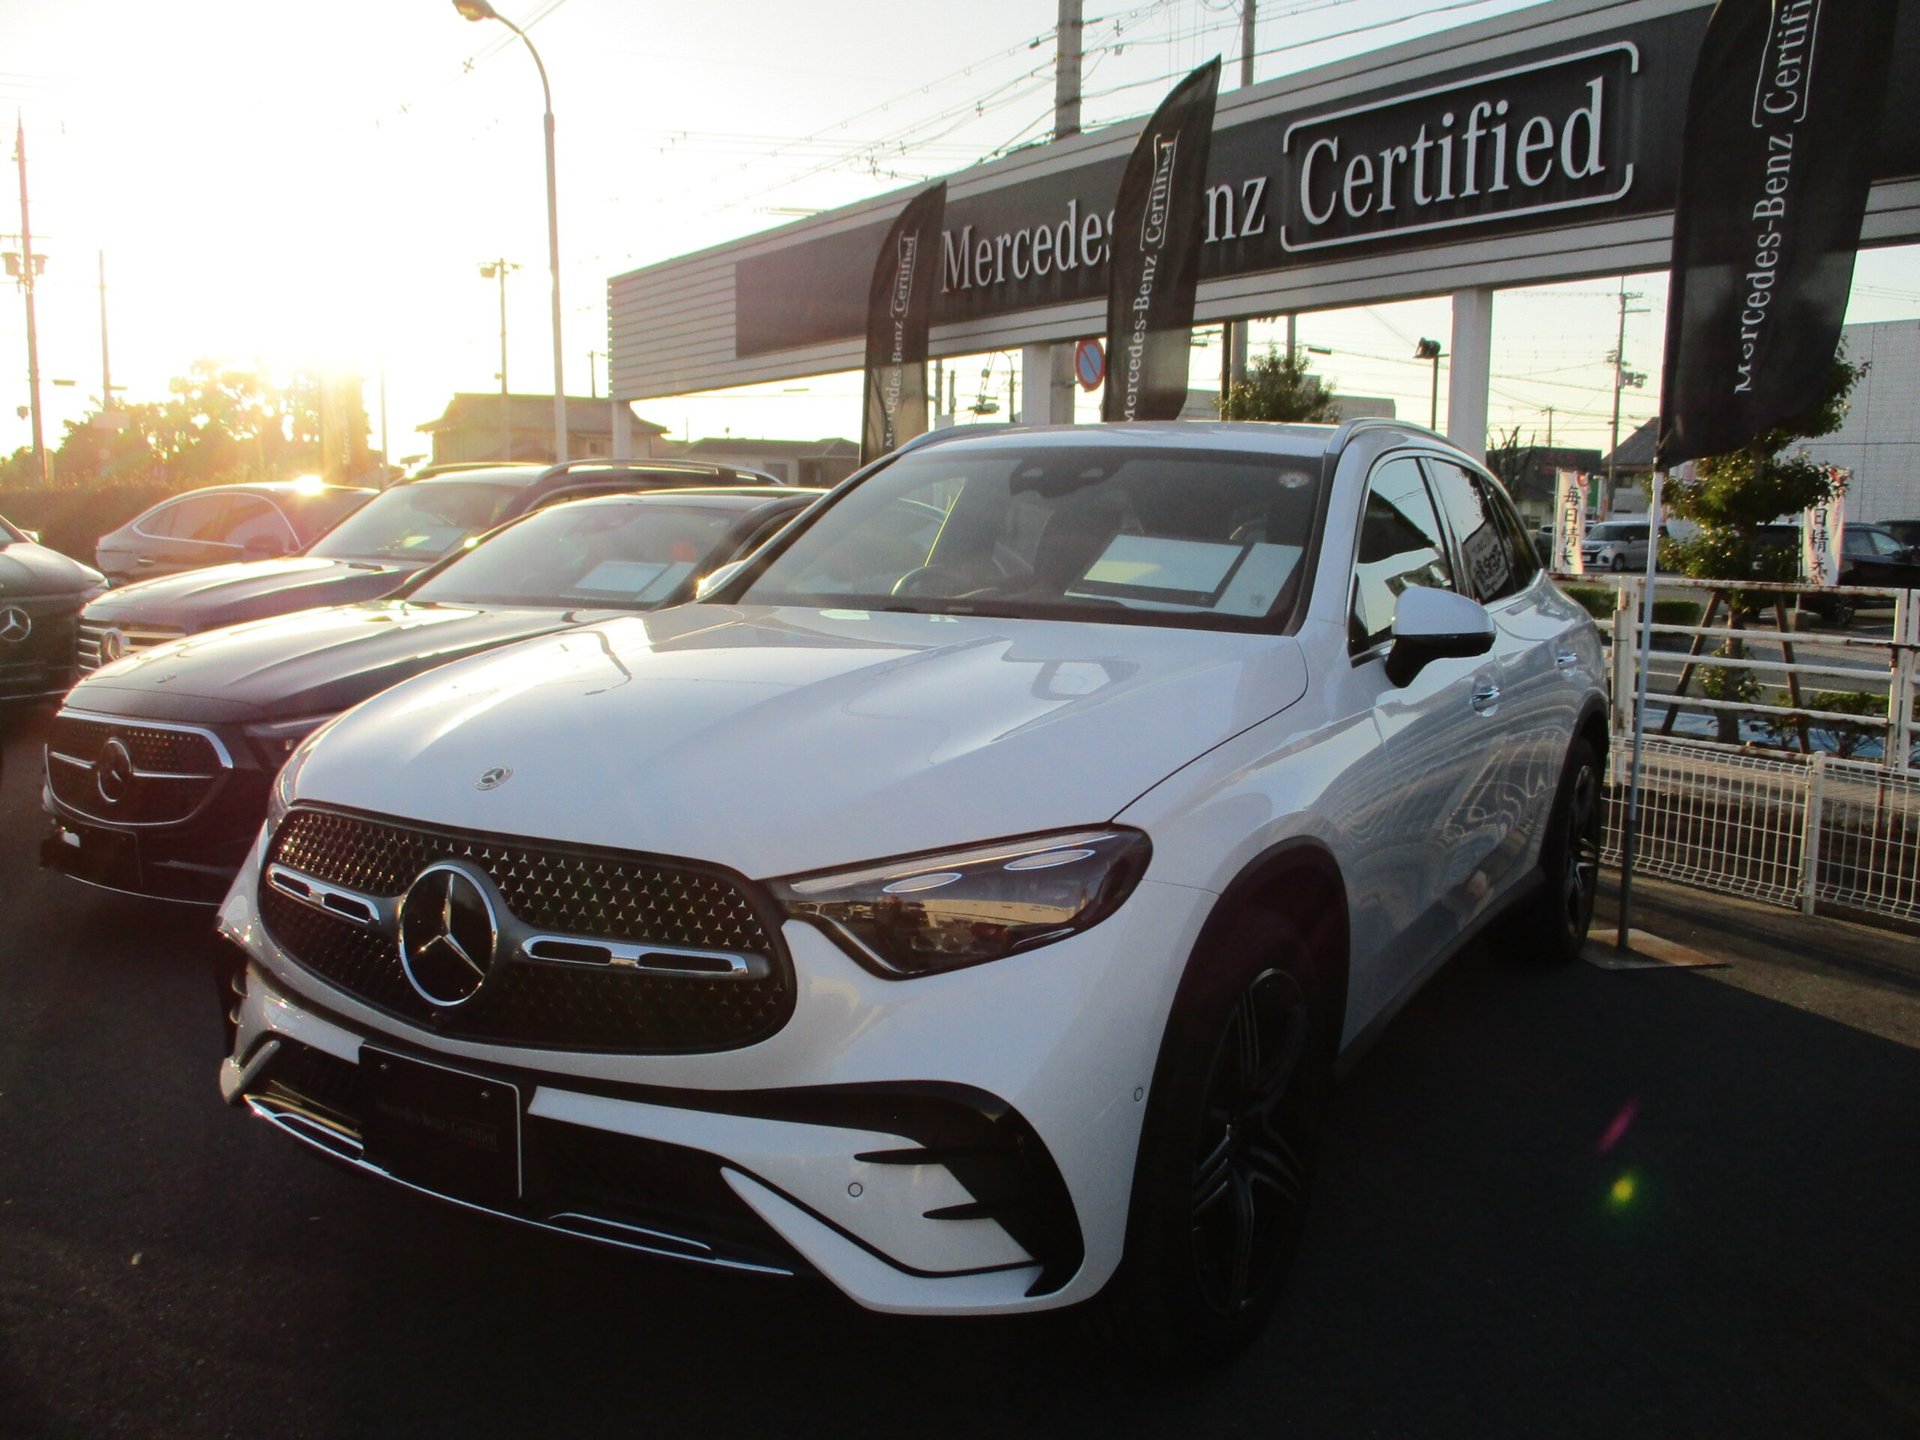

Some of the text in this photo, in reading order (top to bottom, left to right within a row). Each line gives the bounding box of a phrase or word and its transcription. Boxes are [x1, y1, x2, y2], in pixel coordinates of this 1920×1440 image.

[1300, 76, 1606, 225] Certified
[885, 236, 916, 448] Mcedes-Benz Certified
[1808, 498, 1829, 580] 日精米
